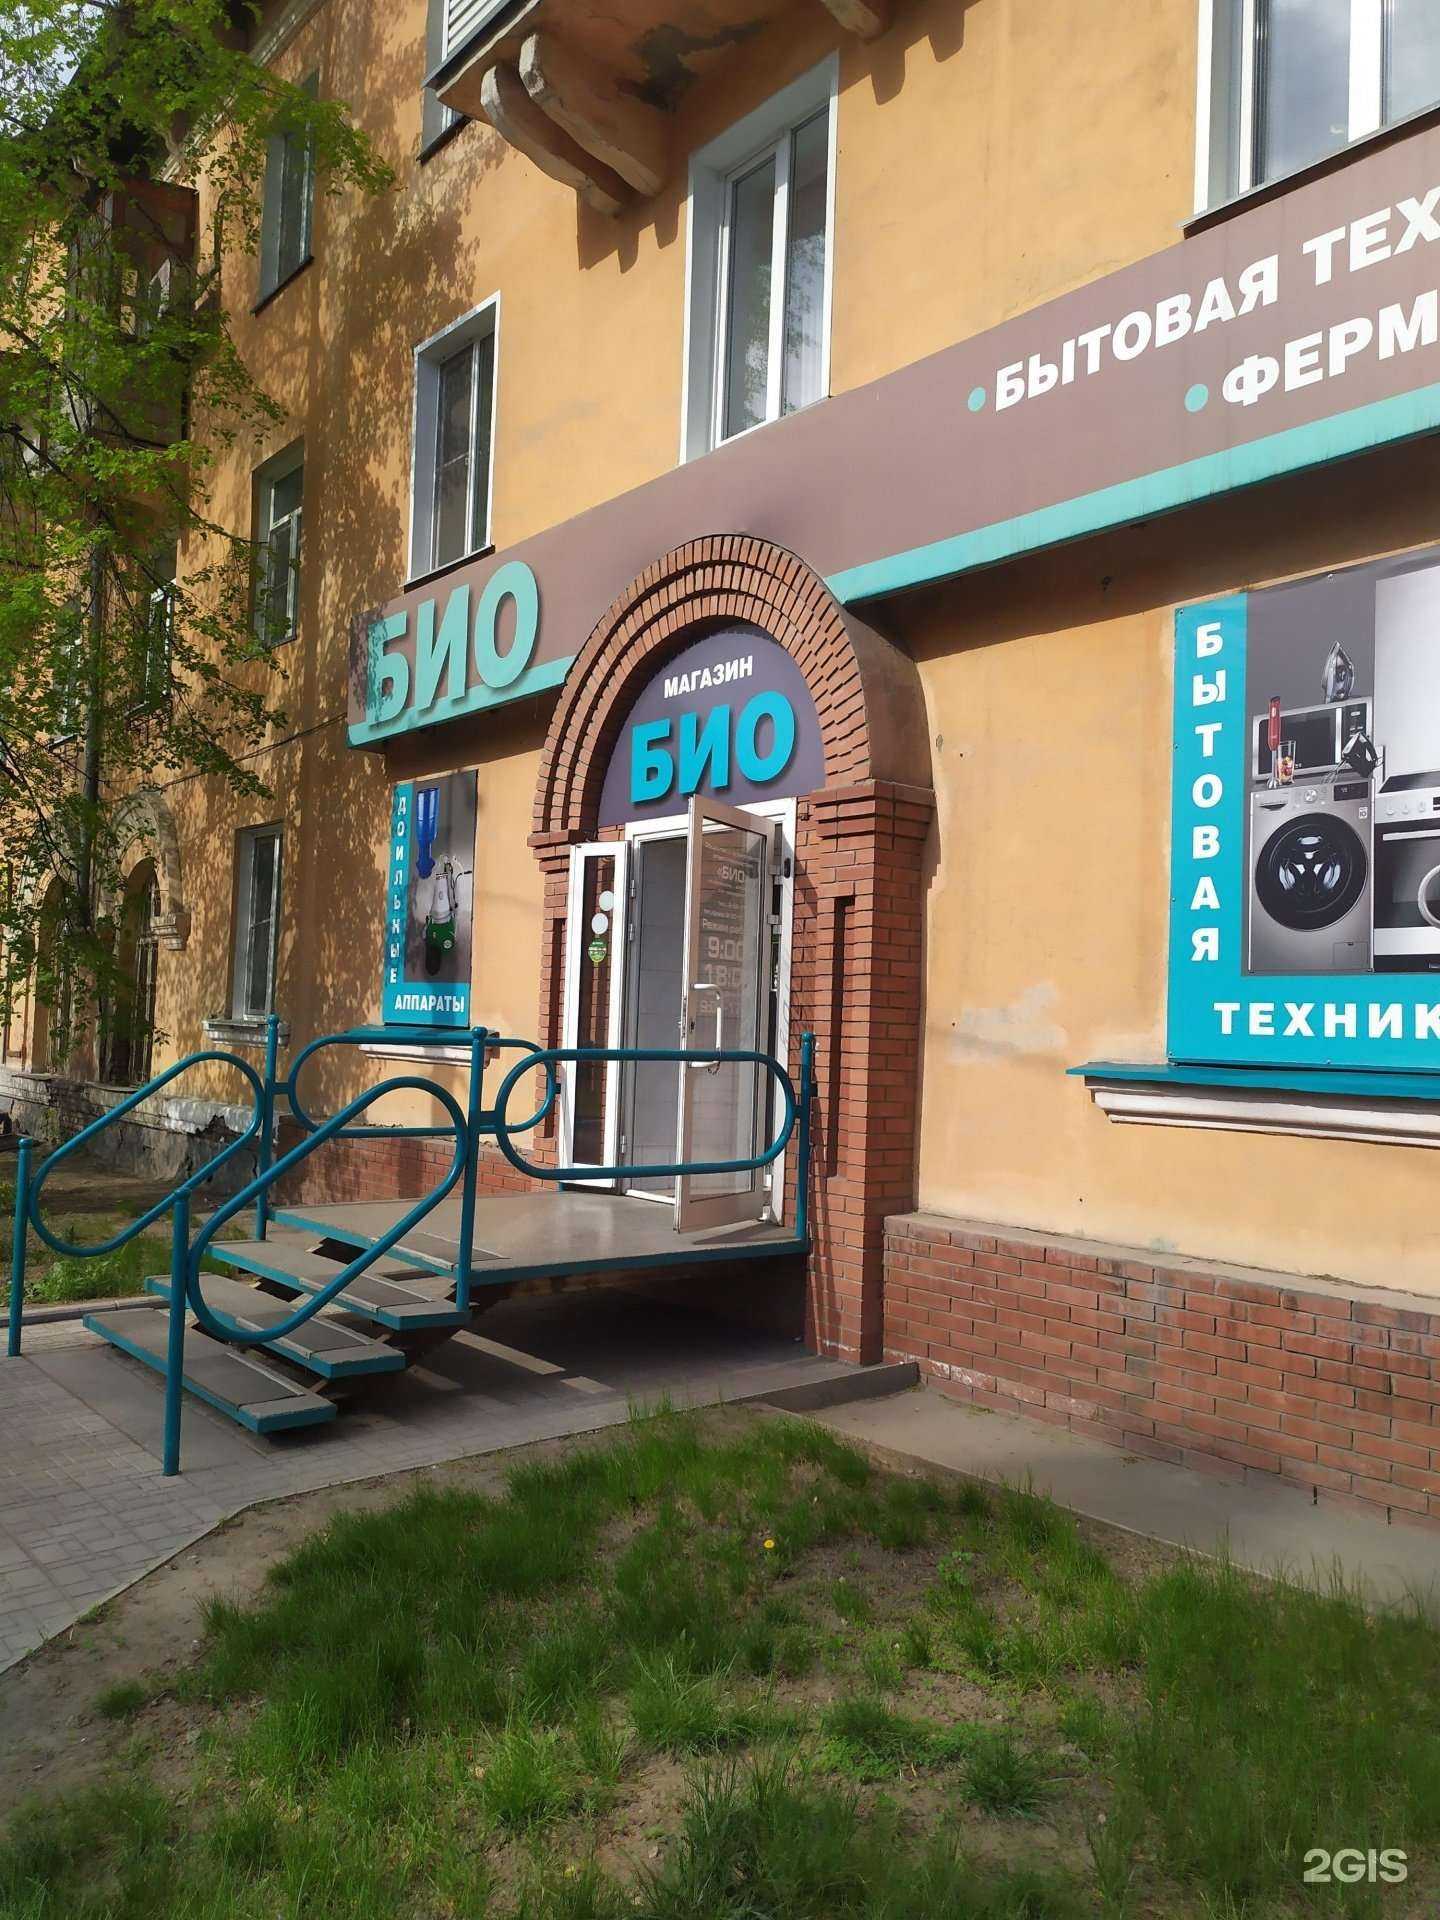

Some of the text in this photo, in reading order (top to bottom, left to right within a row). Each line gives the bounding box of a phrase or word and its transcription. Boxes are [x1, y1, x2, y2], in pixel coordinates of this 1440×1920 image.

[994, 186, 1440, 412] БЫТОВАЯ ТЕХ
[1221, 288, 1438, 407] ФЕРМ
[366, 560, 539, 728] БИО
[663, 655, 754, 699] МАГАЗИН
[630, 690, 796, 805] БИО
[1190, 621, 1227, 963] БЫТОВАЯ
[389, 796, 407, 984] ДОИЛЬНЫЕ
[395, 994, 465, 1013] АППАРАТЫ
[1213, 1002, 1440, 1040] ТЕХНИК
